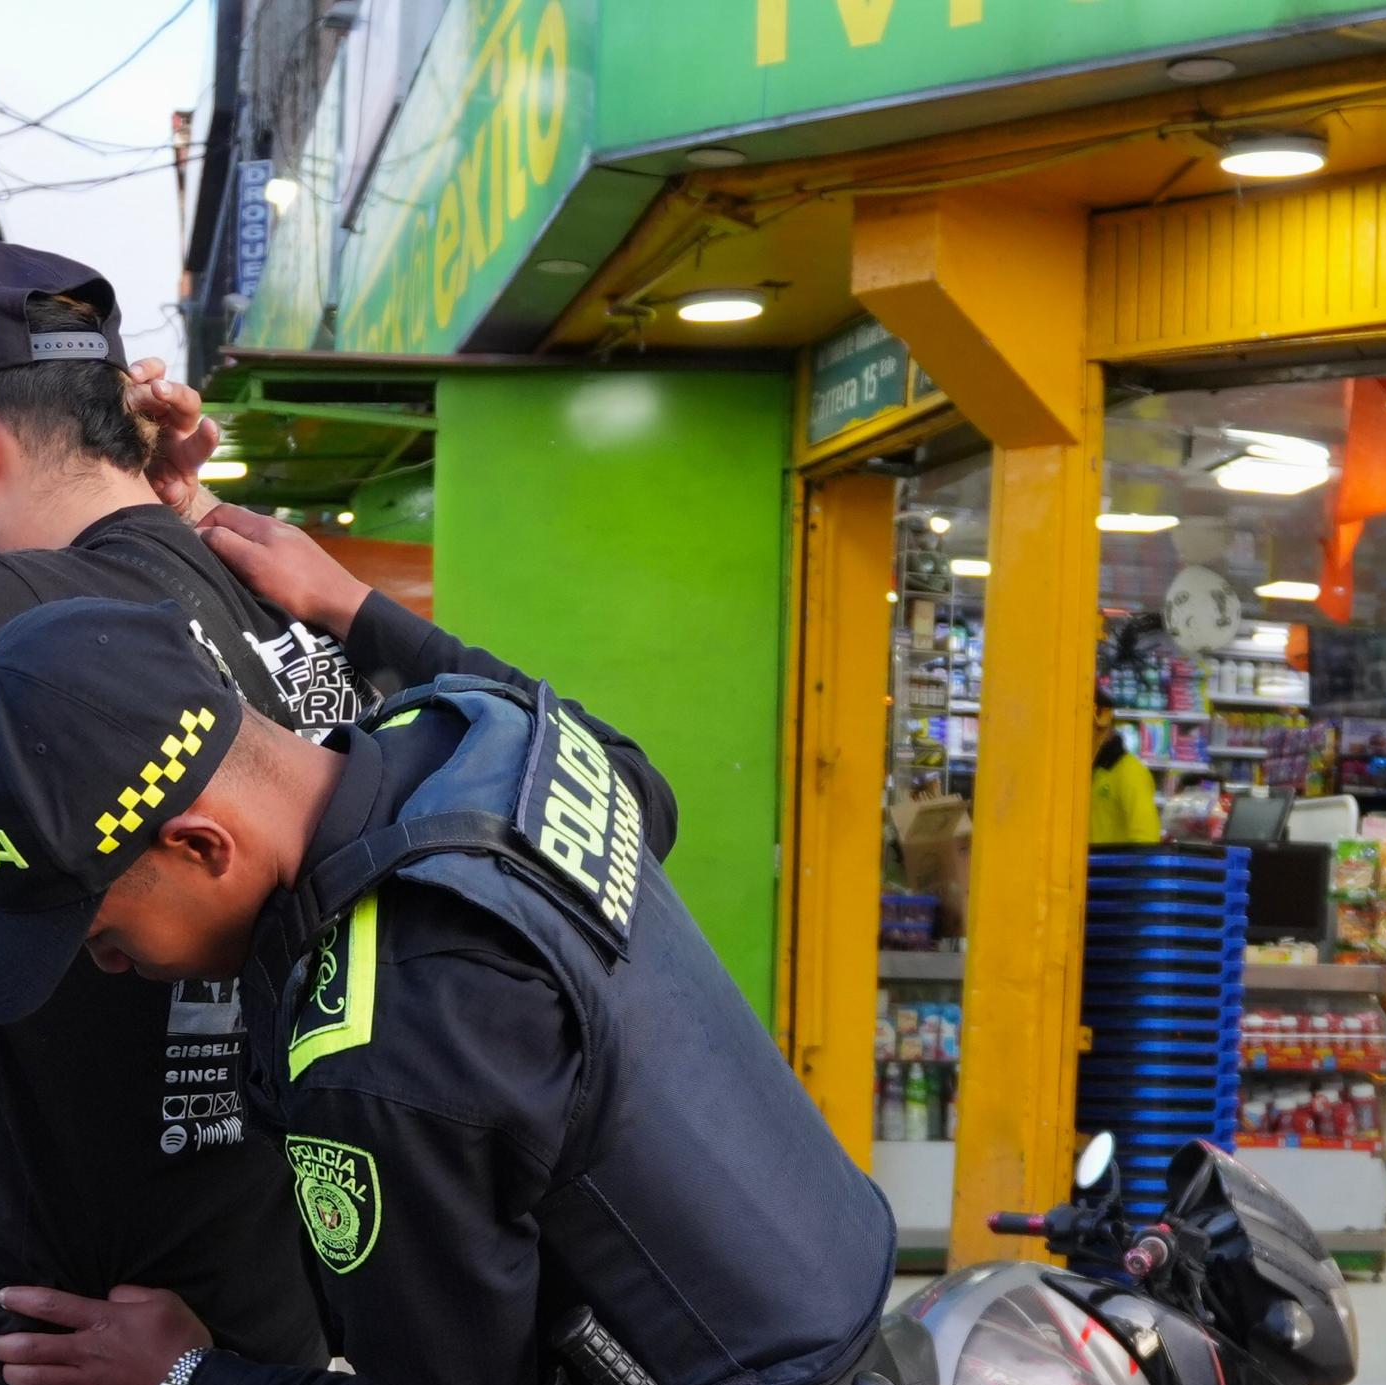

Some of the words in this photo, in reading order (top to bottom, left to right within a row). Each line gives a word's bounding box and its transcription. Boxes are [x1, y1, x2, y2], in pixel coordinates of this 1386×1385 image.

[863, 362, 877, 401] 15
[165, 1067, 229, 1084] SINCE
[289, 1144, 356, 1177] POLICÍA
